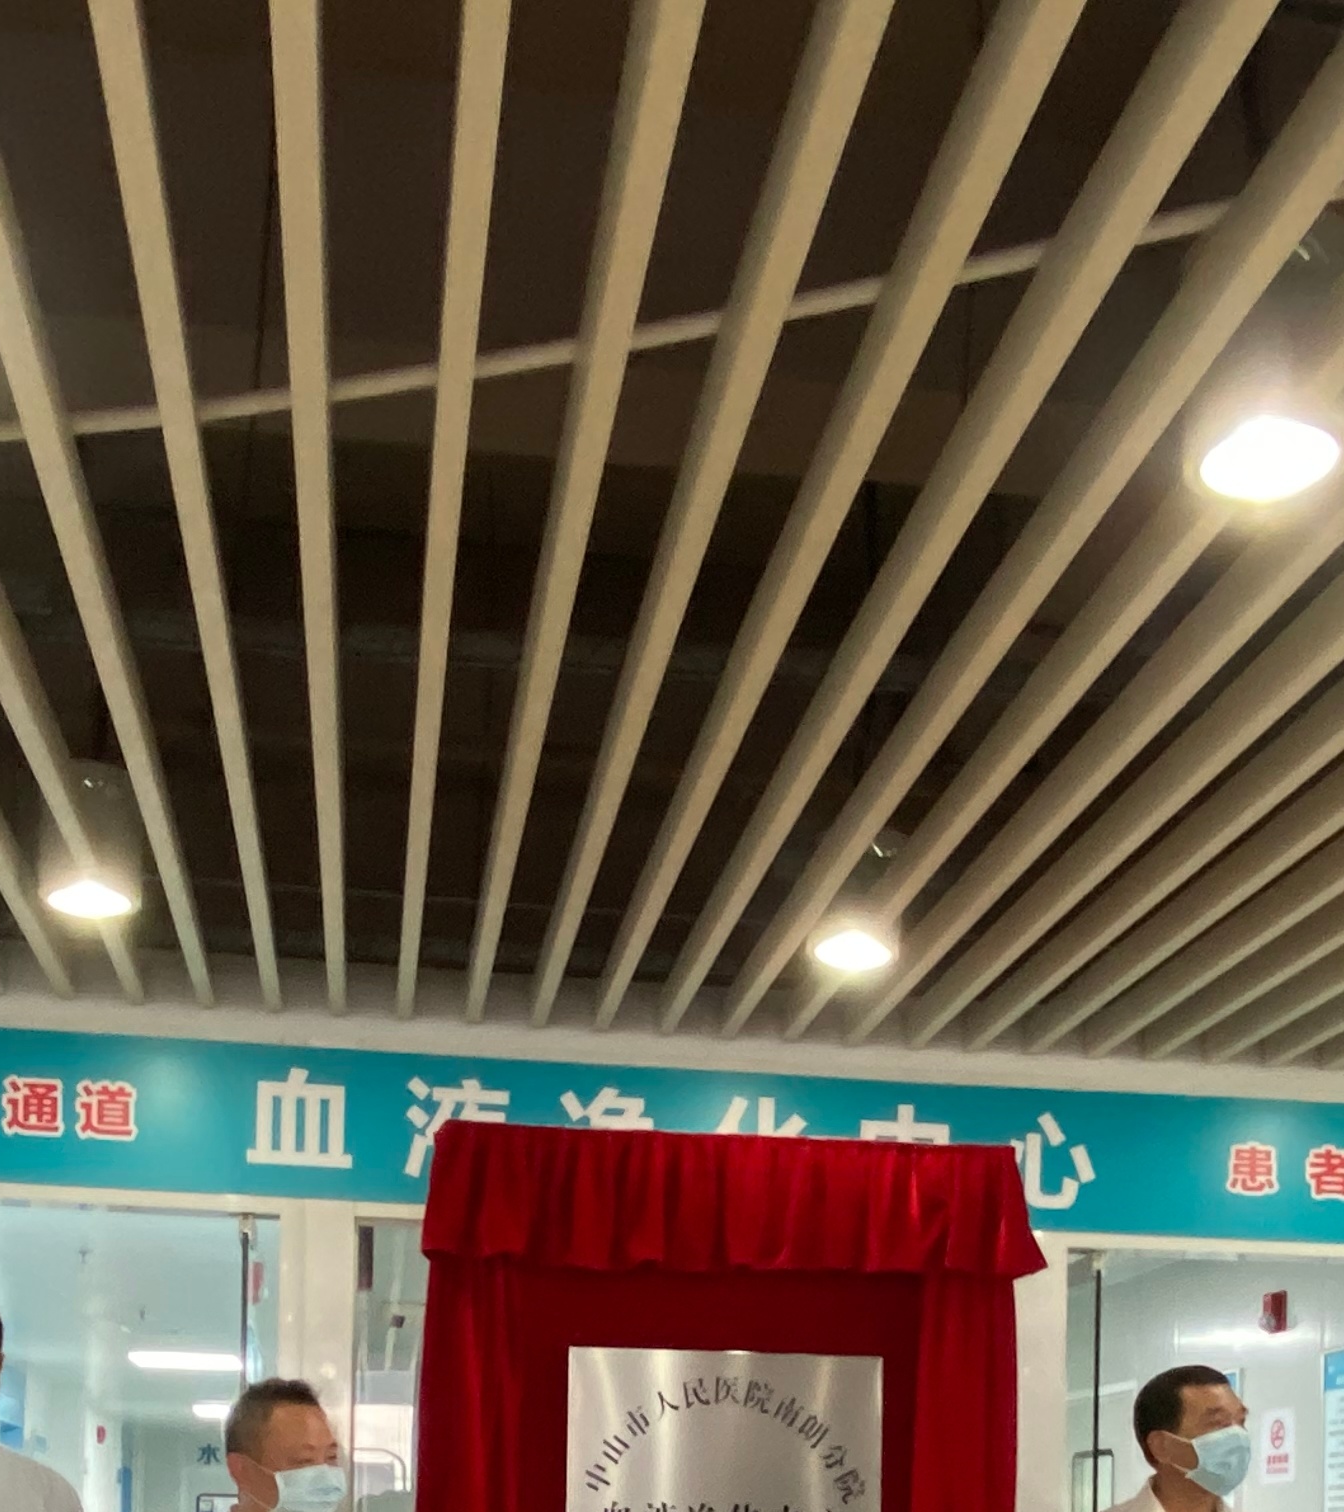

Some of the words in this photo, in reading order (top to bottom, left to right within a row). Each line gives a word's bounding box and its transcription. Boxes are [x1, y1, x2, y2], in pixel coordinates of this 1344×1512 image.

[585, 1376, 866, 1504] 中山市人民医院南朗分院
